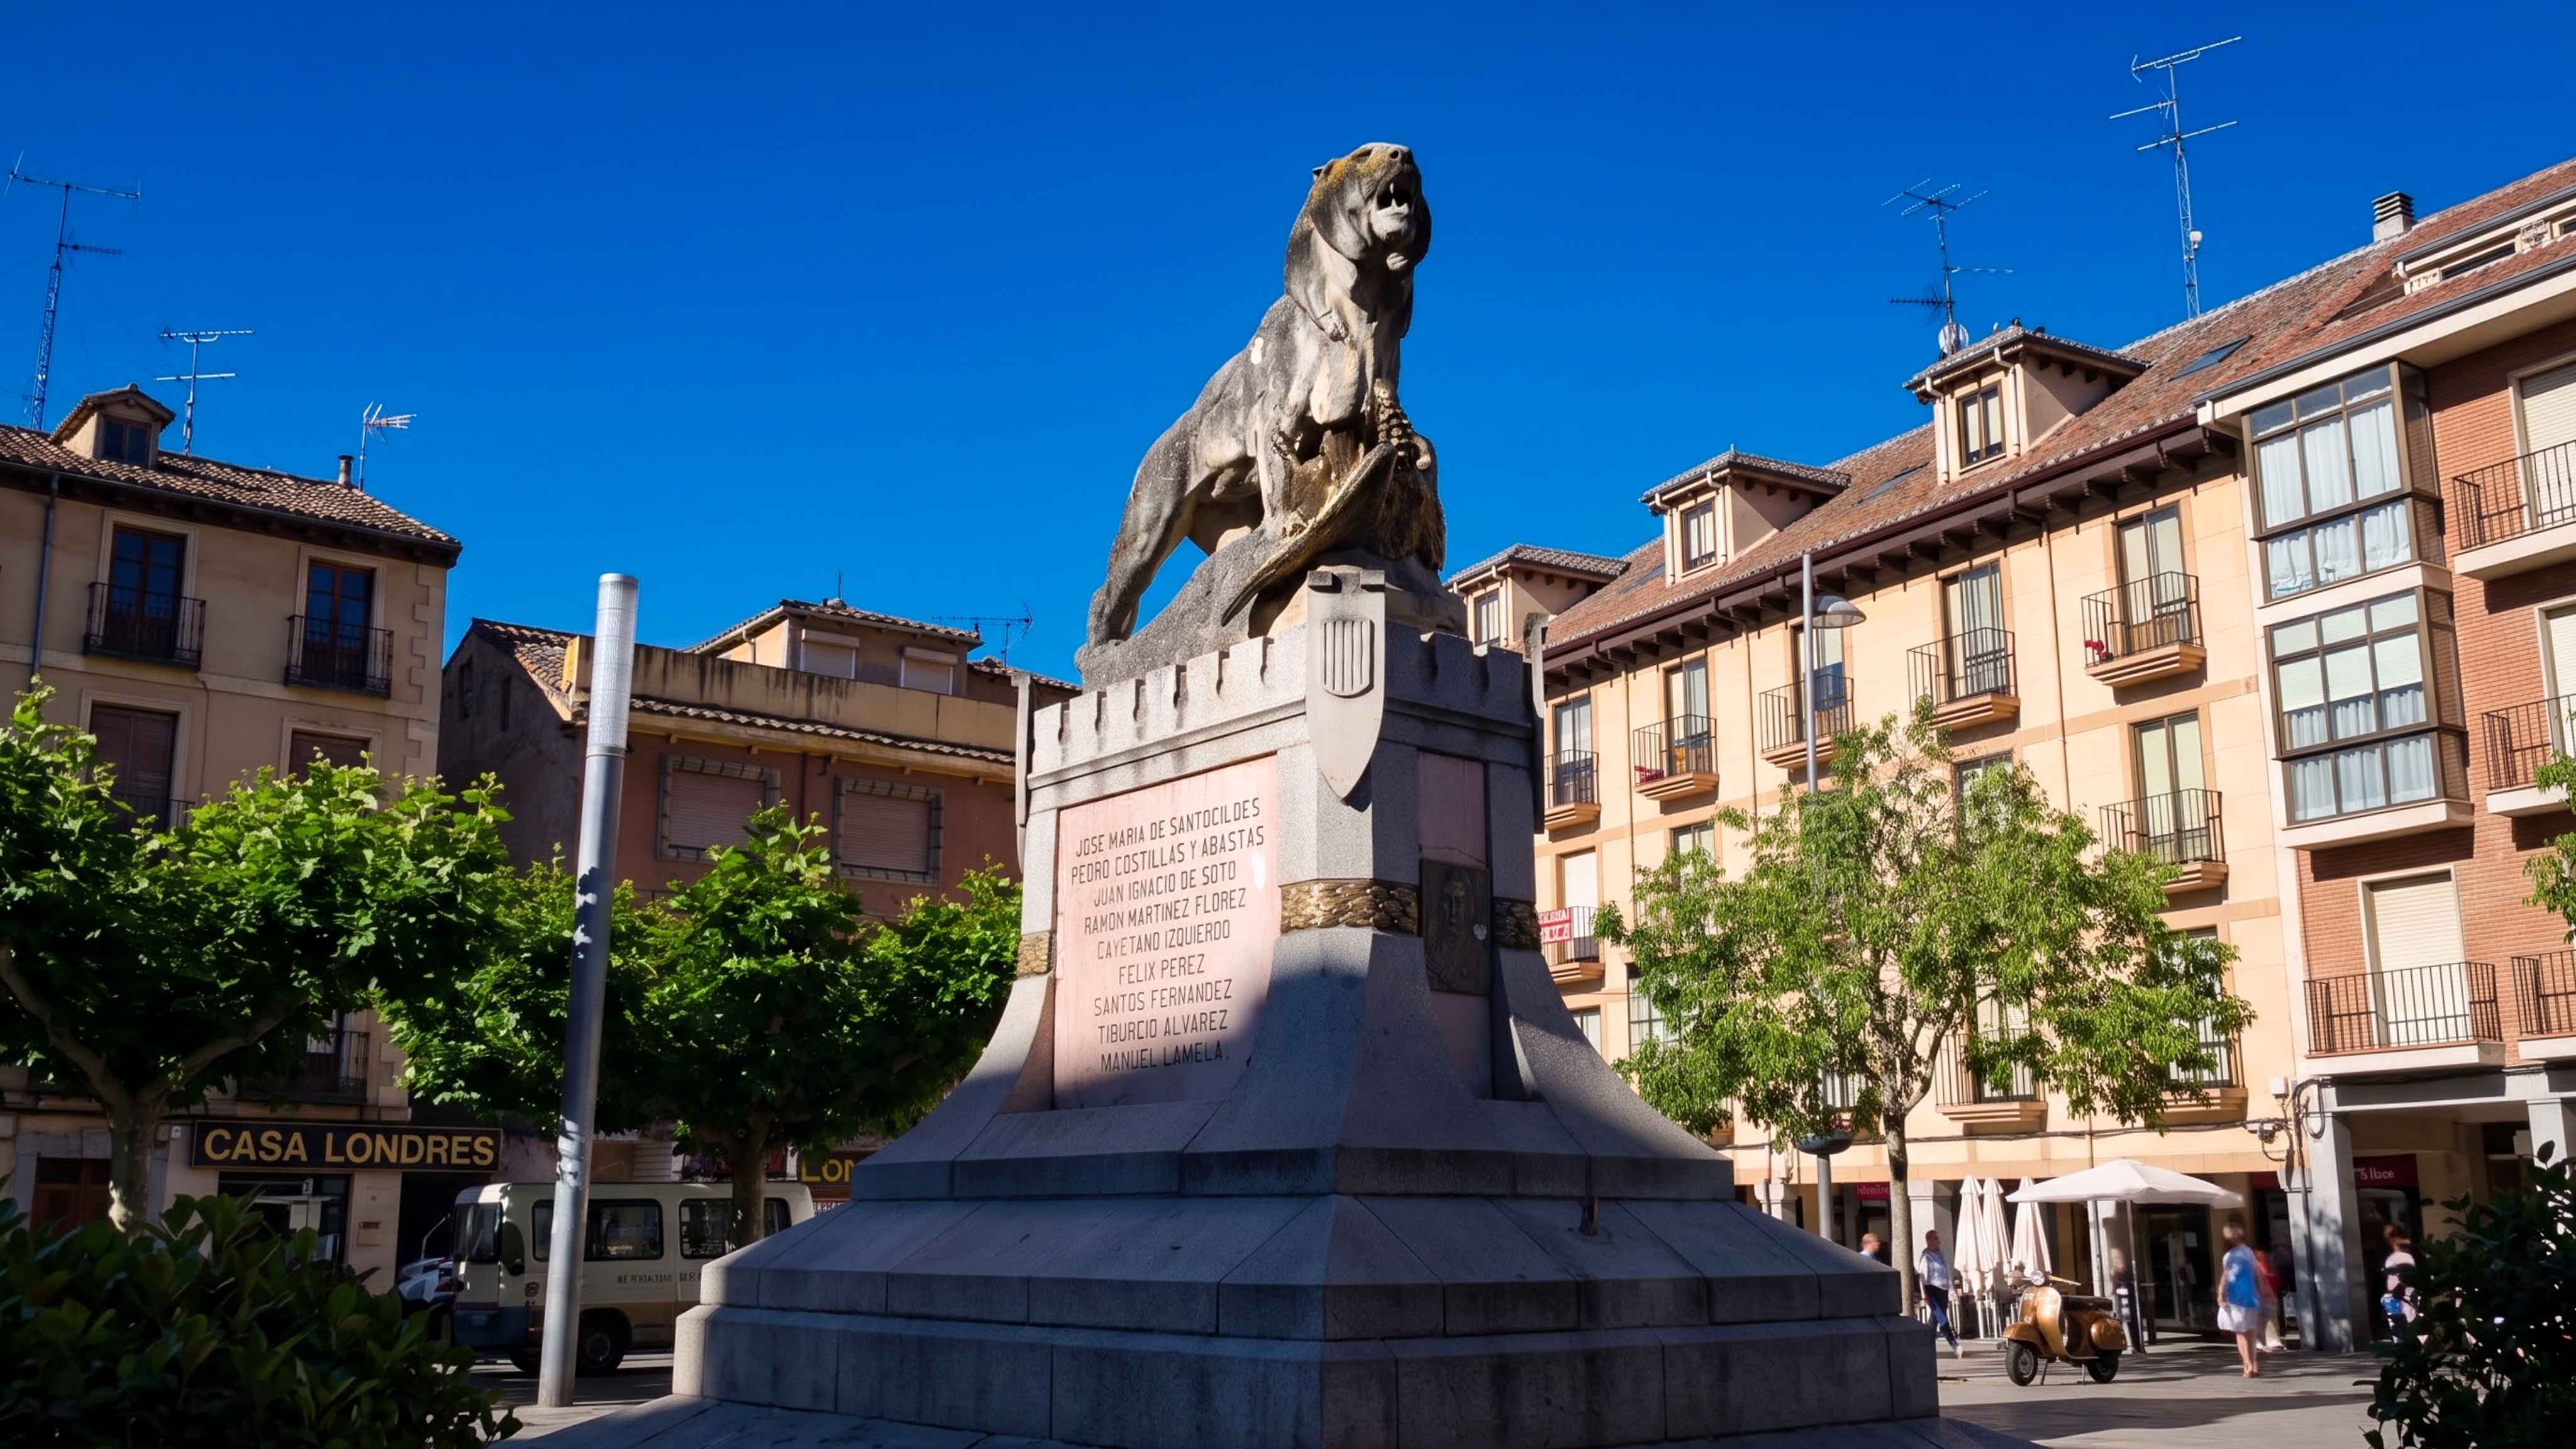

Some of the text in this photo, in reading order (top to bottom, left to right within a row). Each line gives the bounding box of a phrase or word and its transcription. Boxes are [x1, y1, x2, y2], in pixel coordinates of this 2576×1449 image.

[1076, 797, 1260, 857] JOSE MARIA DE SANTOCILDES
[1071, 825, 1264, 886] PEDRO COSTILLAS Y ABASTAS
[1094, 860, 1236, 907] JUAN IGNACIO DE SOTO
[1084, 887, 1246, 935] RAMON MARTINEZ FLOREZ
[1097, 919, 1230, 960] CAYETANO IZQUIERDO
[1118, 953, 1206, 985] FELIX PEREZ
[1094, 979, 1233, 1016] SANTOS FERNANDEZ
[1098, 1009, 1228, 1045] TIBURCIO ALVAREZ
[1101, 1047, 1157, 1073] MANUEL
[204, 1128, 494, 1166] CASA LONDRES
